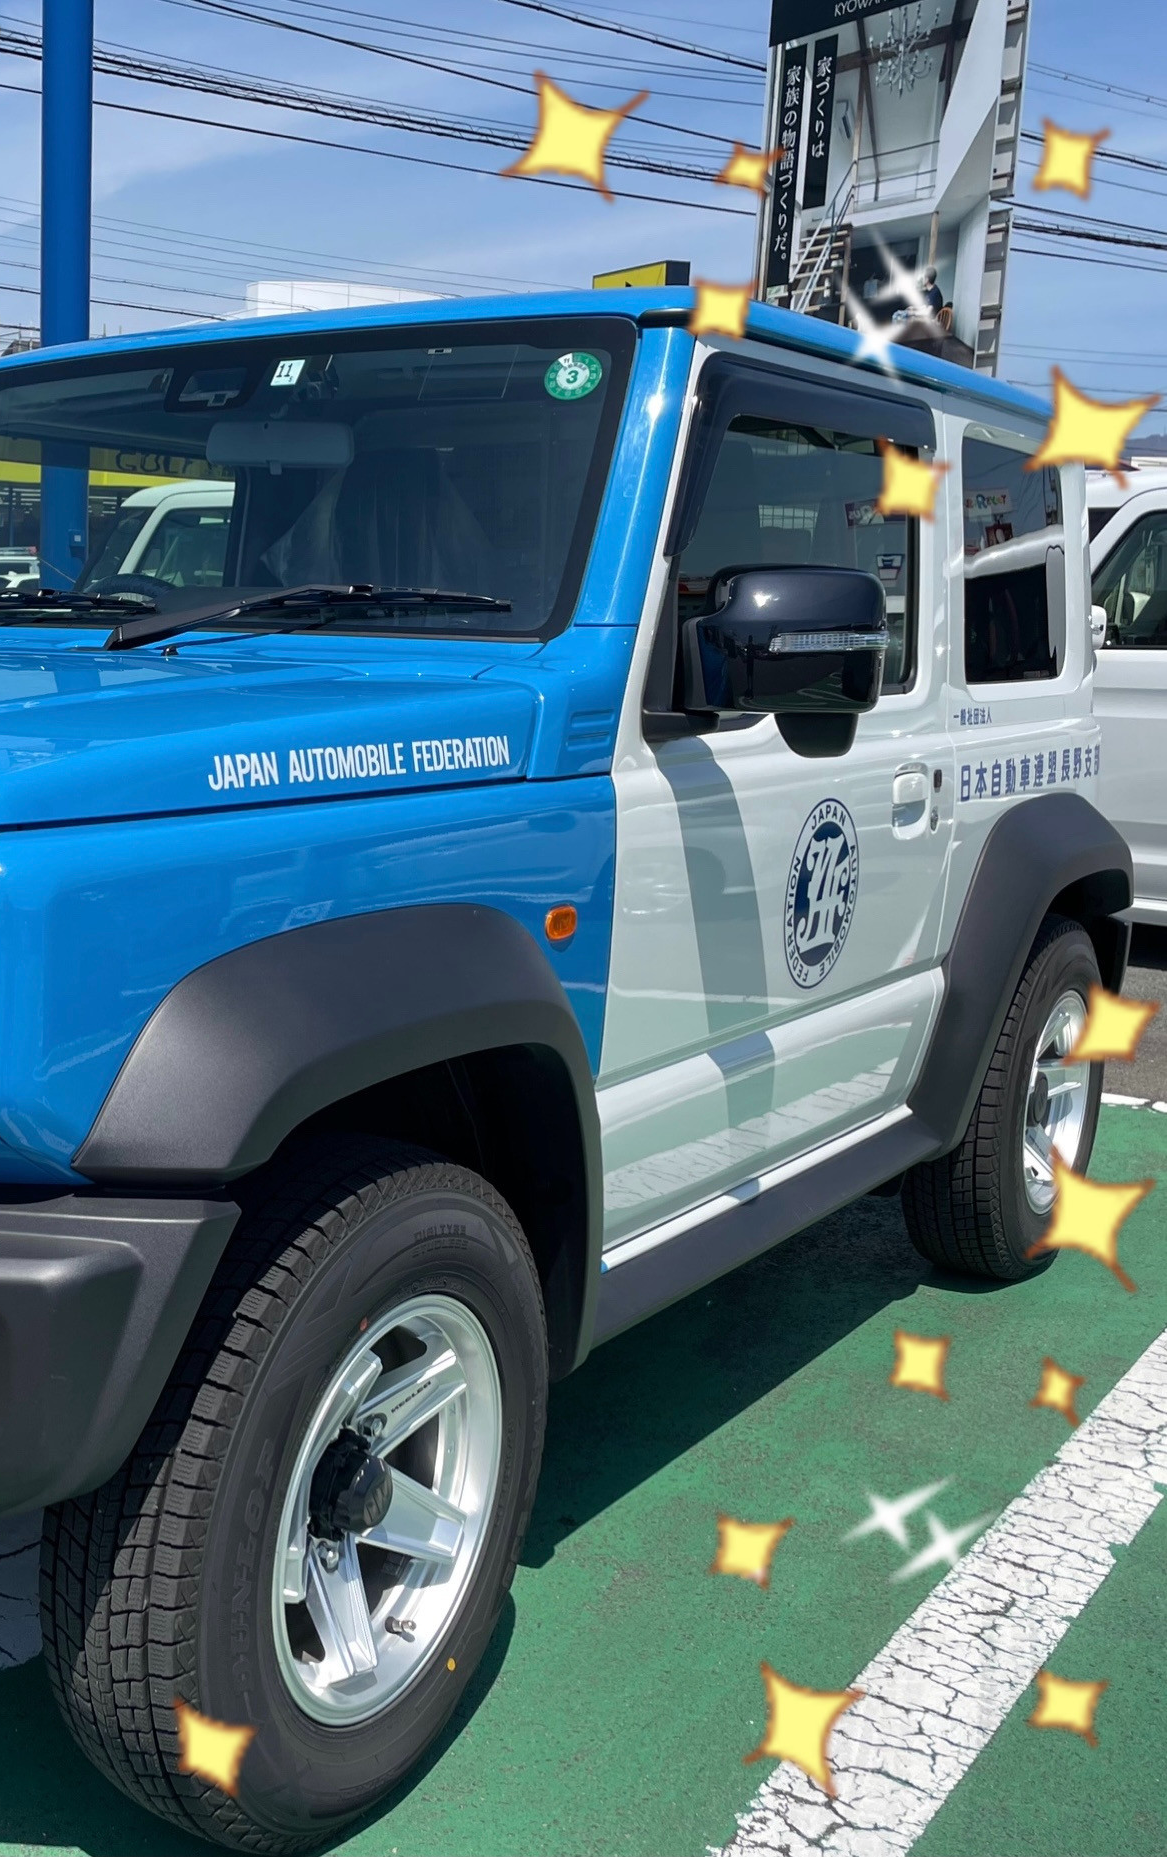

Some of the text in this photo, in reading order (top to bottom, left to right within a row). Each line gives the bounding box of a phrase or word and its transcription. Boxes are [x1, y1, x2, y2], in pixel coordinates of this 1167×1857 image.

[834, 0, 881, 17] KYOW
[812, 56, 832, 158] 家づくりは
[276, 363, 293, 378] 11
[566, 370, 579, 384] 3
[953, 706, 992, 726] 一般社団法人
[208, 735, 511, 791] JAPAN AUTOMOBILE FEDERATION
[786, 804, 857, 982] JAPAN AUTOMOBILE FEDERATION
